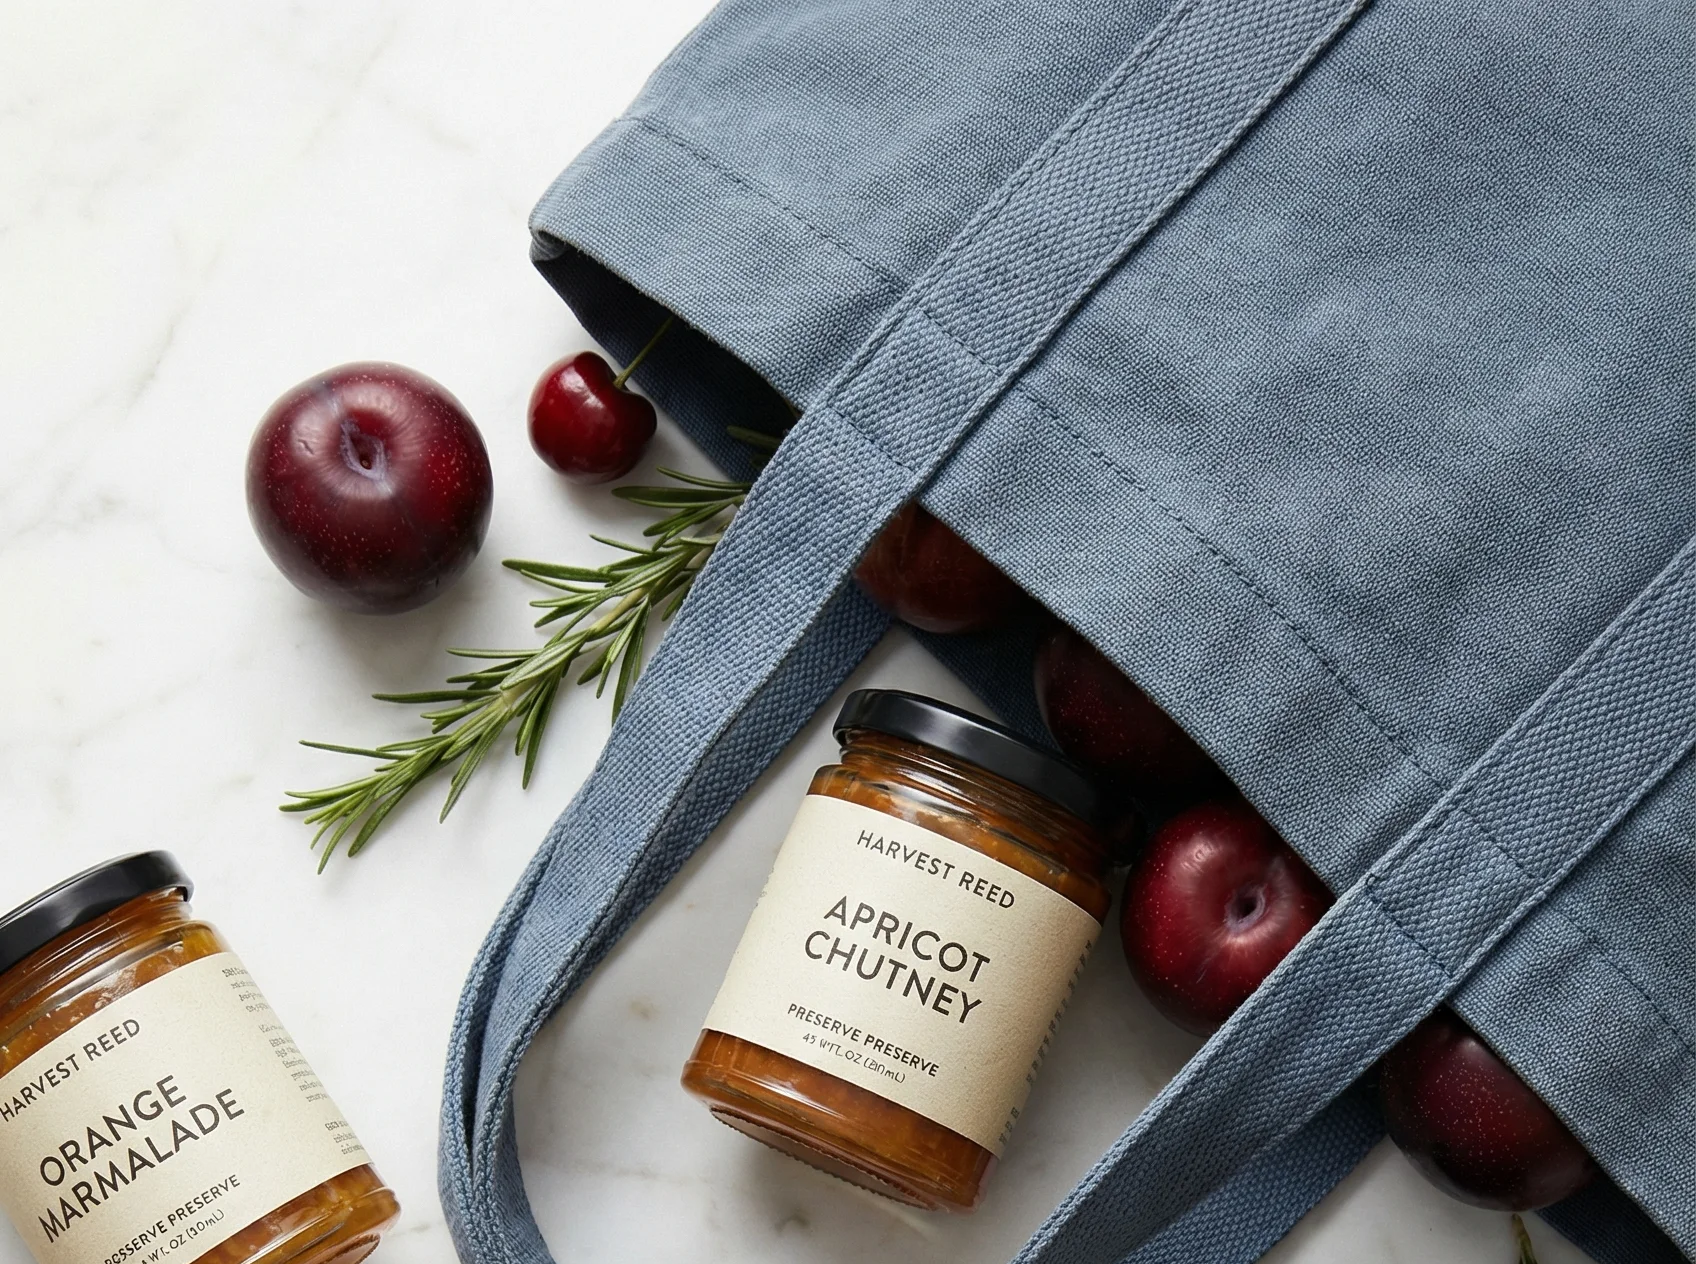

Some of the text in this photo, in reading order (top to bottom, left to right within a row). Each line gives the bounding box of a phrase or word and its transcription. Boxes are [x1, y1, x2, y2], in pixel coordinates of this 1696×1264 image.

[856, 829, 1015, 909] HARVEST REED
[804, 930, 983, 1023] CHUTNEY
[823, 895, 991, 983] APRICOT
[0, 1019, 140, 1123] HARVEST REED
[787, 1003, 940, 1078] PRESERVE PRESERVE
[37, 1088, 245, 1248] MARMALADE
[39, 1074, 187, 1187] ORANGE
[167, 1174, 241, 1227] PRESERVE
